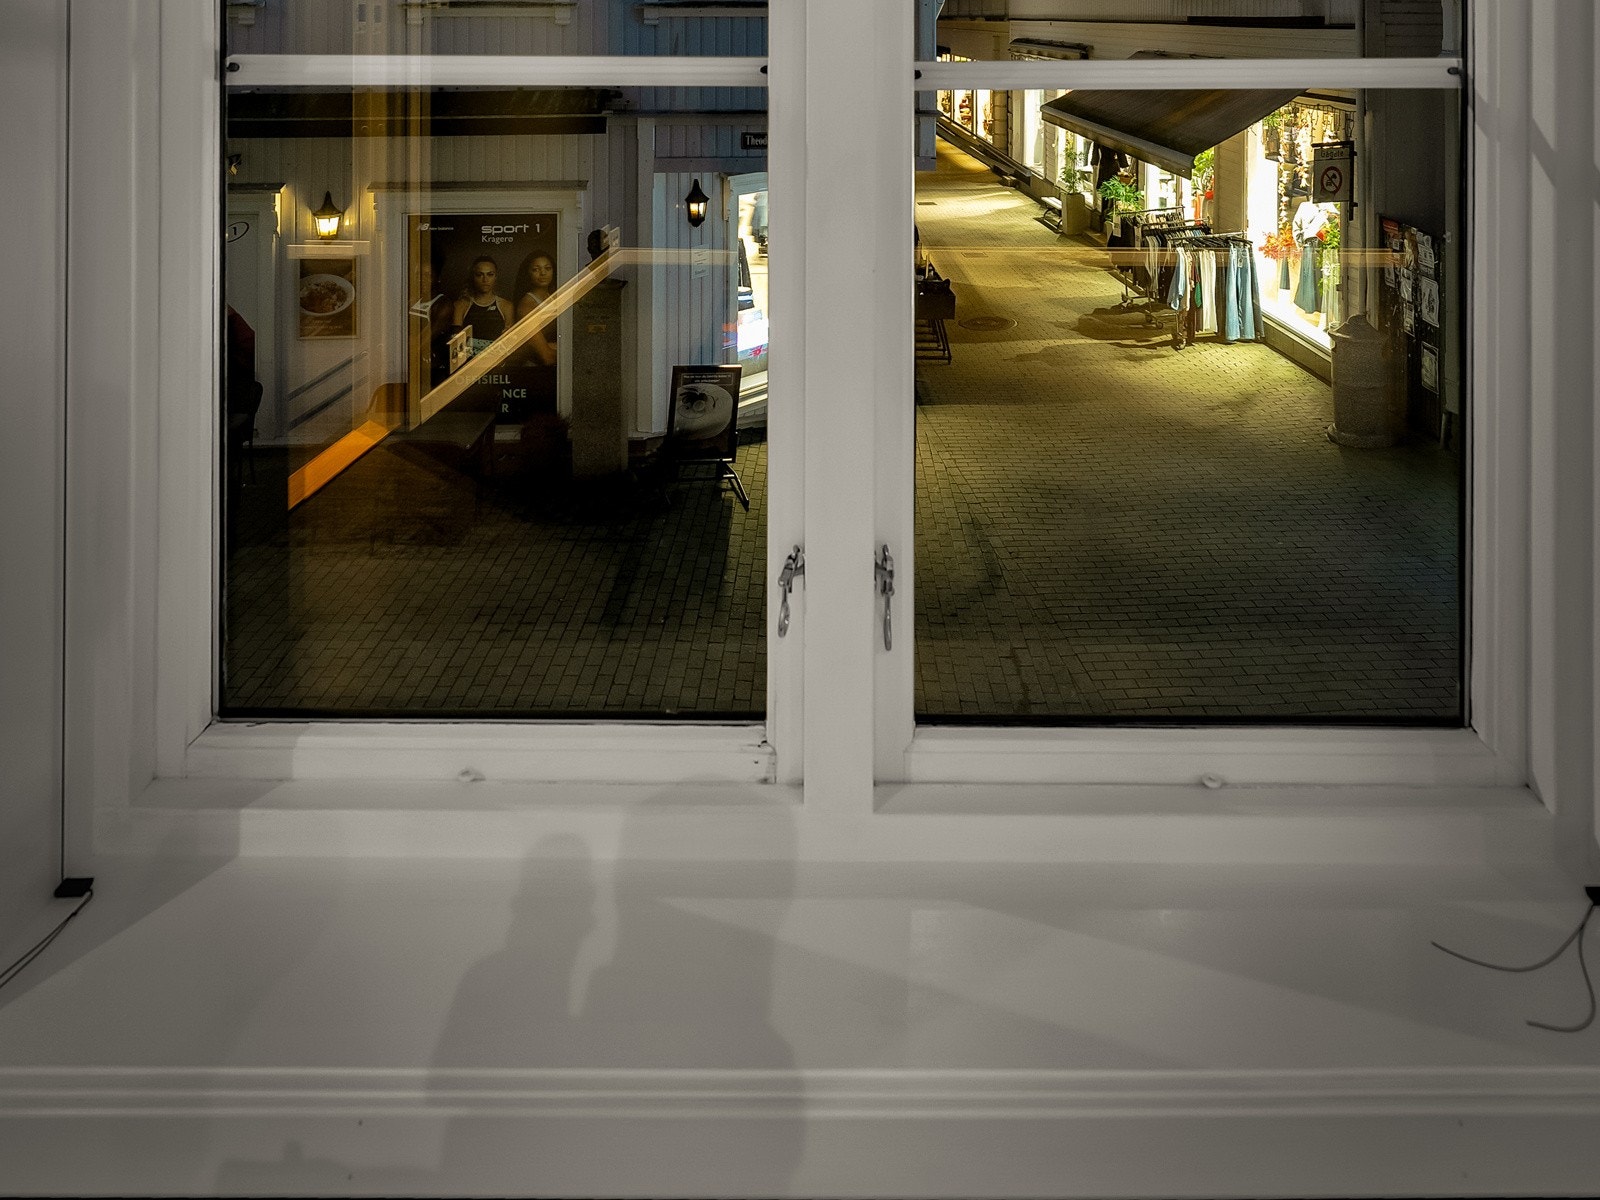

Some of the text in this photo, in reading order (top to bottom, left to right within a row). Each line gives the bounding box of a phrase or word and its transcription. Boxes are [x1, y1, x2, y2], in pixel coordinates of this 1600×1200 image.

[481, 223, 541, 236] sport 1
[481, 235, 514, 245] Kragerø
